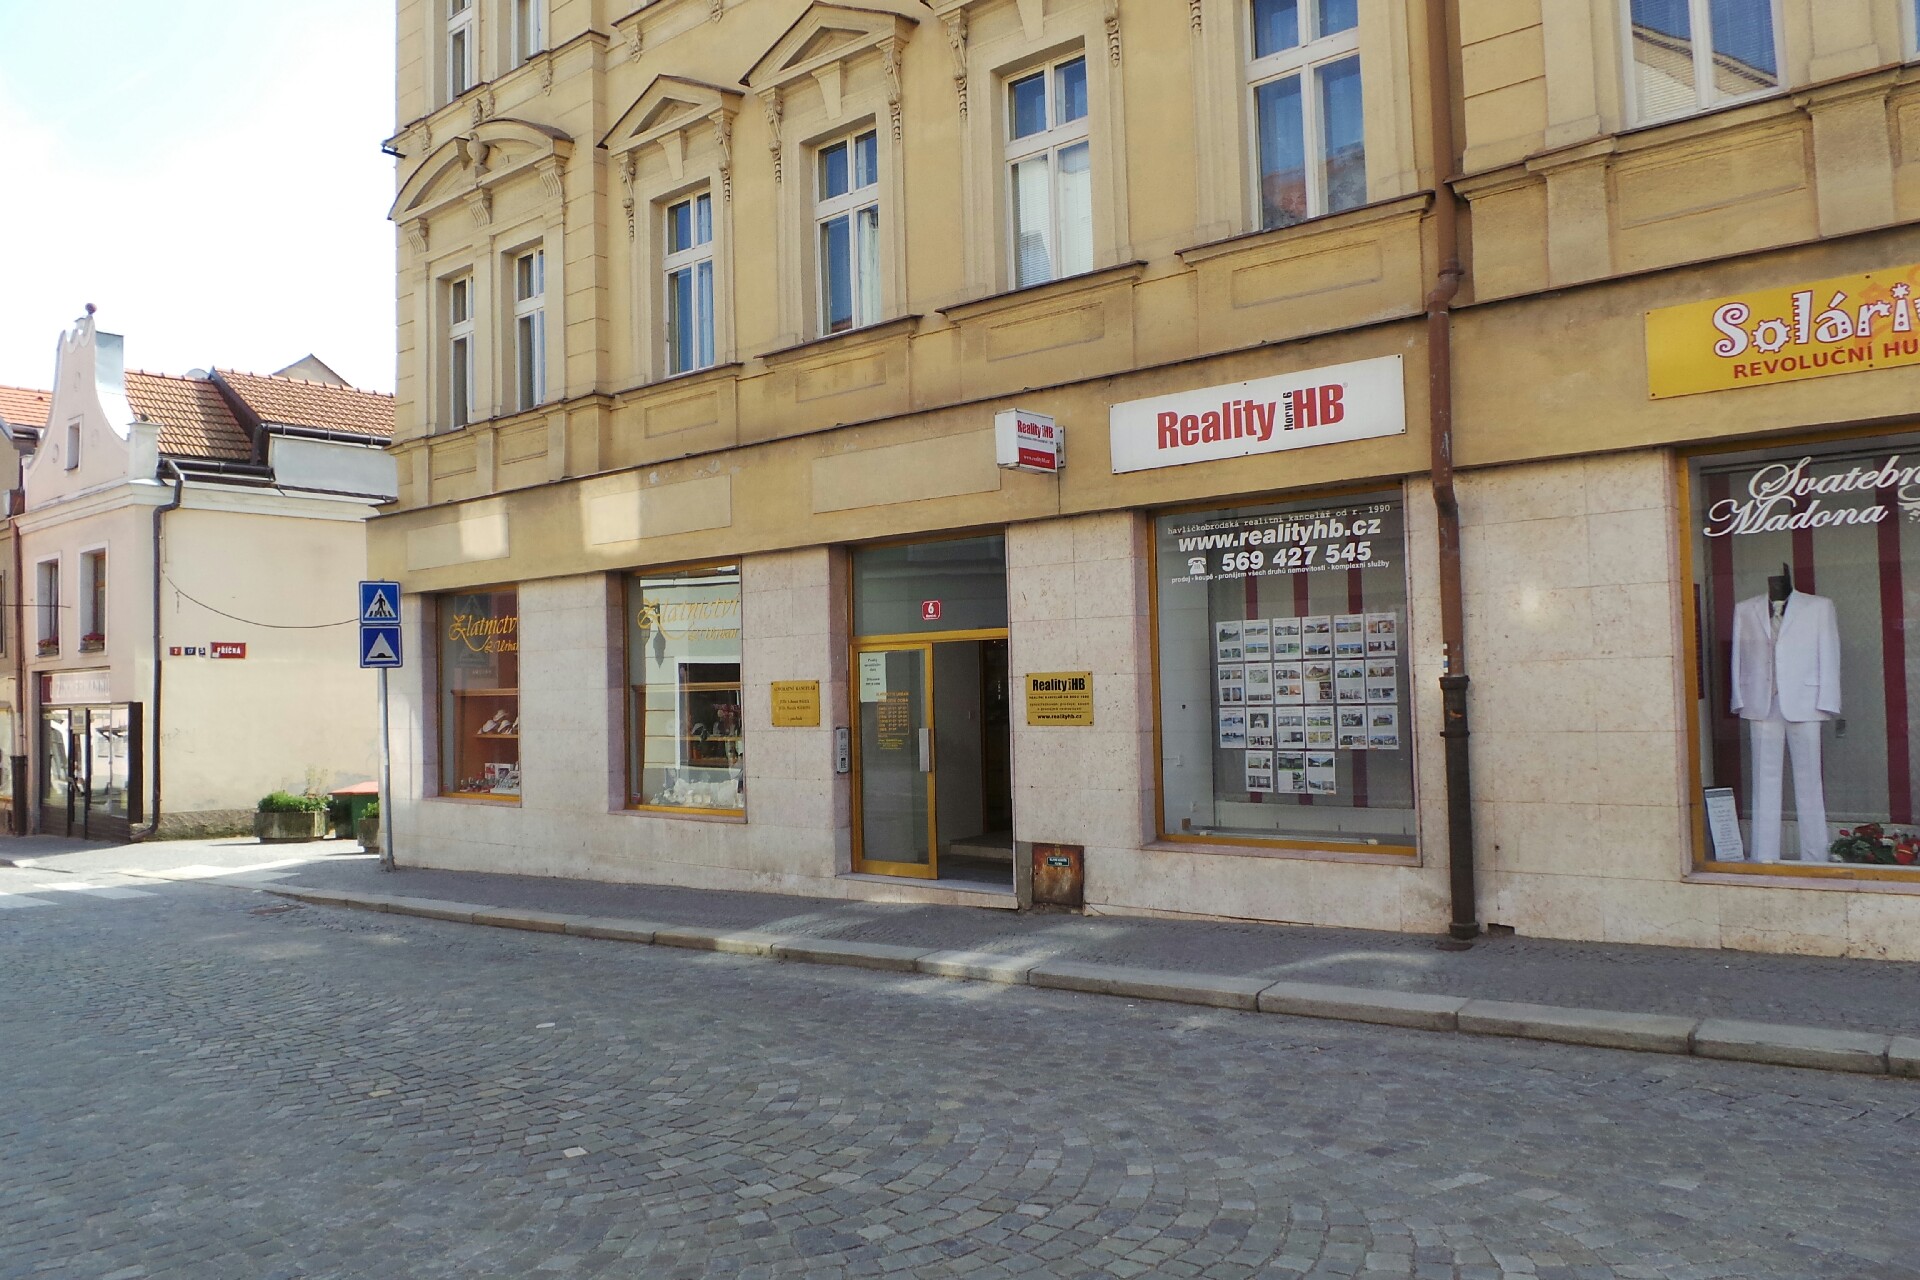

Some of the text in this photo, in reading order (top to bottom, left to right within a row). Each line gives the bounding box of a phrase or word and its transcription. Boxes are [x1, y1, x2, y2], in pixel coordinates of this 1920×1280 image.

[1733, 341, 1874, 378] REVOLUČNÍ
[1017, 419, 1041, 438] Reality
[1157, 383, 1345, 450] Reality HB
[1335, 509, 1347, 517] od
[1368, 504, 1391, 513] 1990
[1703, 494, 1889, 537] Madona
[1178, 518, 1381, 552] www.realityhb.cz
[1222, 541, 1372, 572] 569 427 545
[927, 602, 935, 614] 6
[216, 645, 241, 655] PŘÍČNÁ
[1032, 678, 1067, 692] Reality
